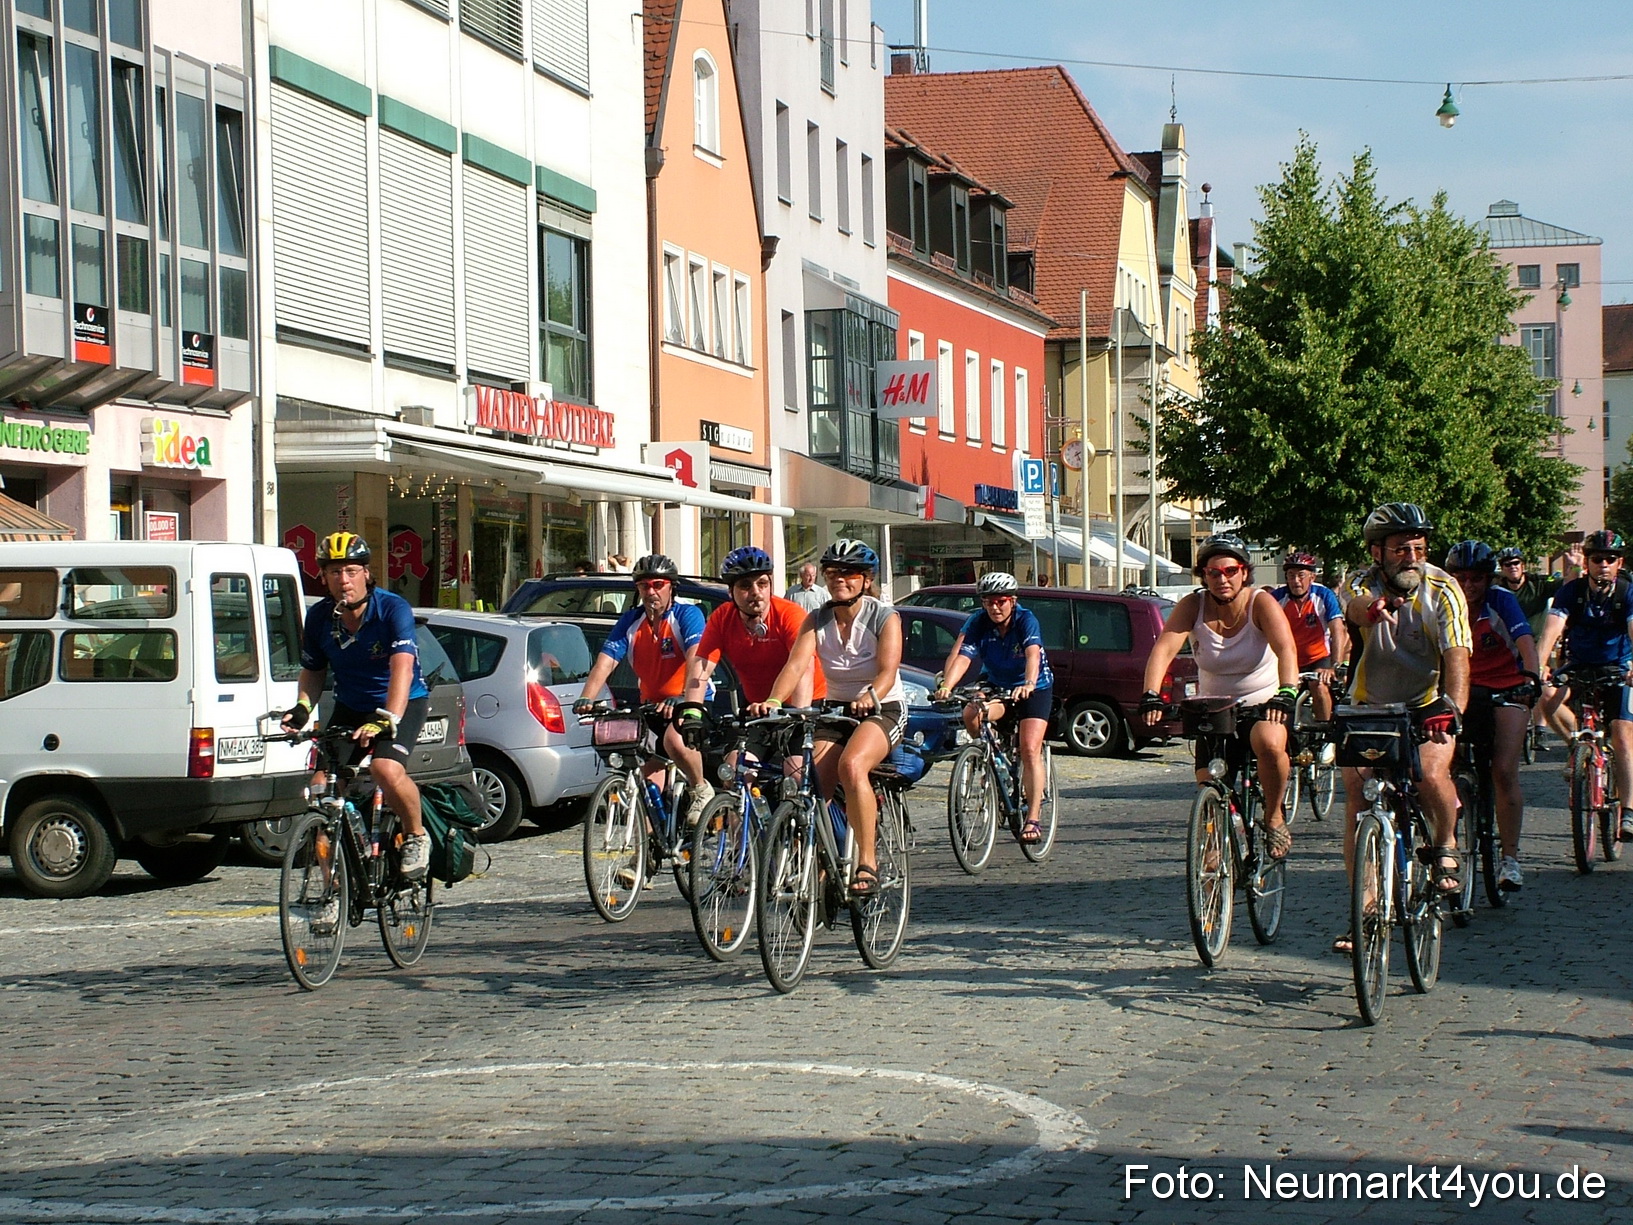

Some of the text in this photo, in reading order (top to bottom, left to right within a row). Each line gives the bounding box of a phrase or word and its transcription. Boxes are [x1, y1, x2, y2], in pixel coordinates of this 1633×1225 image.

[882, 371, 930, 406] H&M
[475, 384, 615, 448] MARIEN-APOTHEKE
[155, 418, 211, 466] idea
[1027, 463, 1039, 490] P
